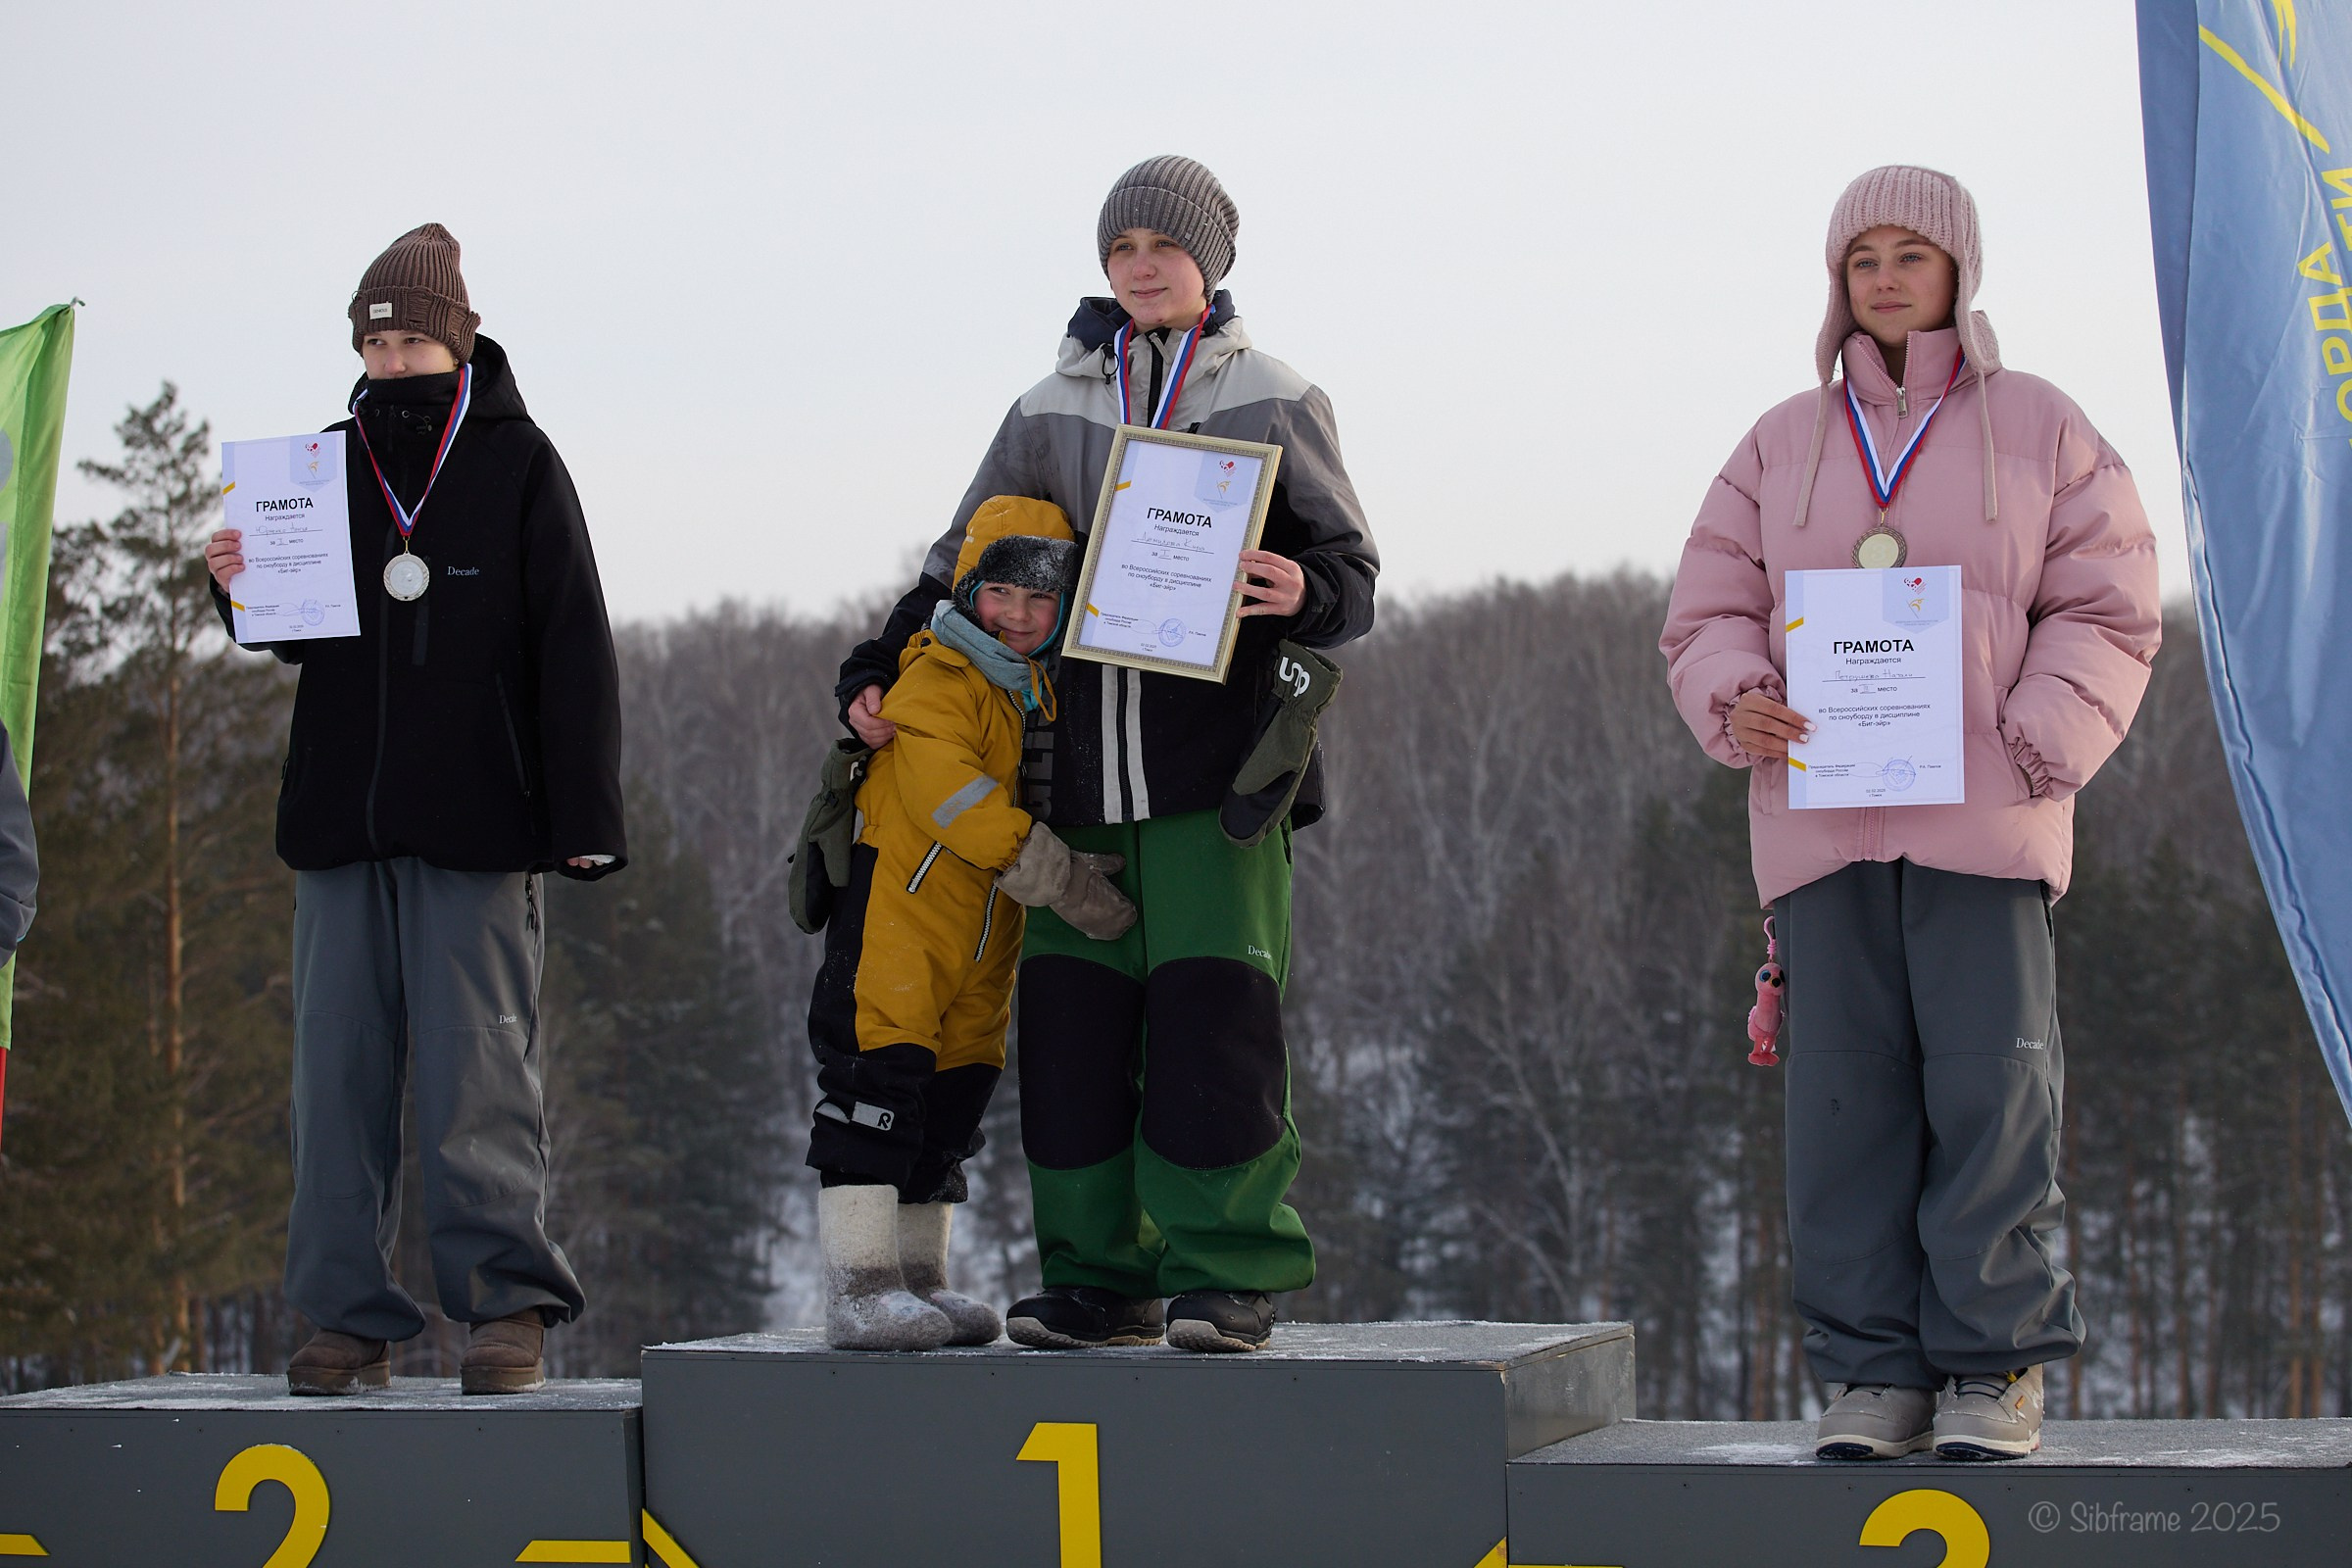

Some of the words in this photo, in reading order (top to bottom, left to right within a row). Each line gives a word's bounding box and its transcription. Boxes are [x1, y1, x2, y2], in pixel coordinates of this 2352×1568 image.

[256, 497, 314, 513] ГРАМОТА
[265, 513, 305, 521] Награждается
[1147, 507, 1212, 528] ГРАМОТА
[1153, 524, 1200, 536] Награждается
[447, 565, 480, 576] Decade
[1129, 564, 1169, 576] Всероссийских
[1170, 571, 1212, 583] соревнованиях
[1135, 573, 1163, 582] сноуборду
[1168, 578, 1201, 588] дисциплине
[1833, 639, 1915, 654] ГРАМОТА
[1845, 657, 1902, 665] Награждается
[1248, 945, 1272, 960] Decad
[2016, 1037, 2044, 1050] Decade
[1015, 1422, 1102, 1568] 1
[215, 1443, 331, 1568] 2
